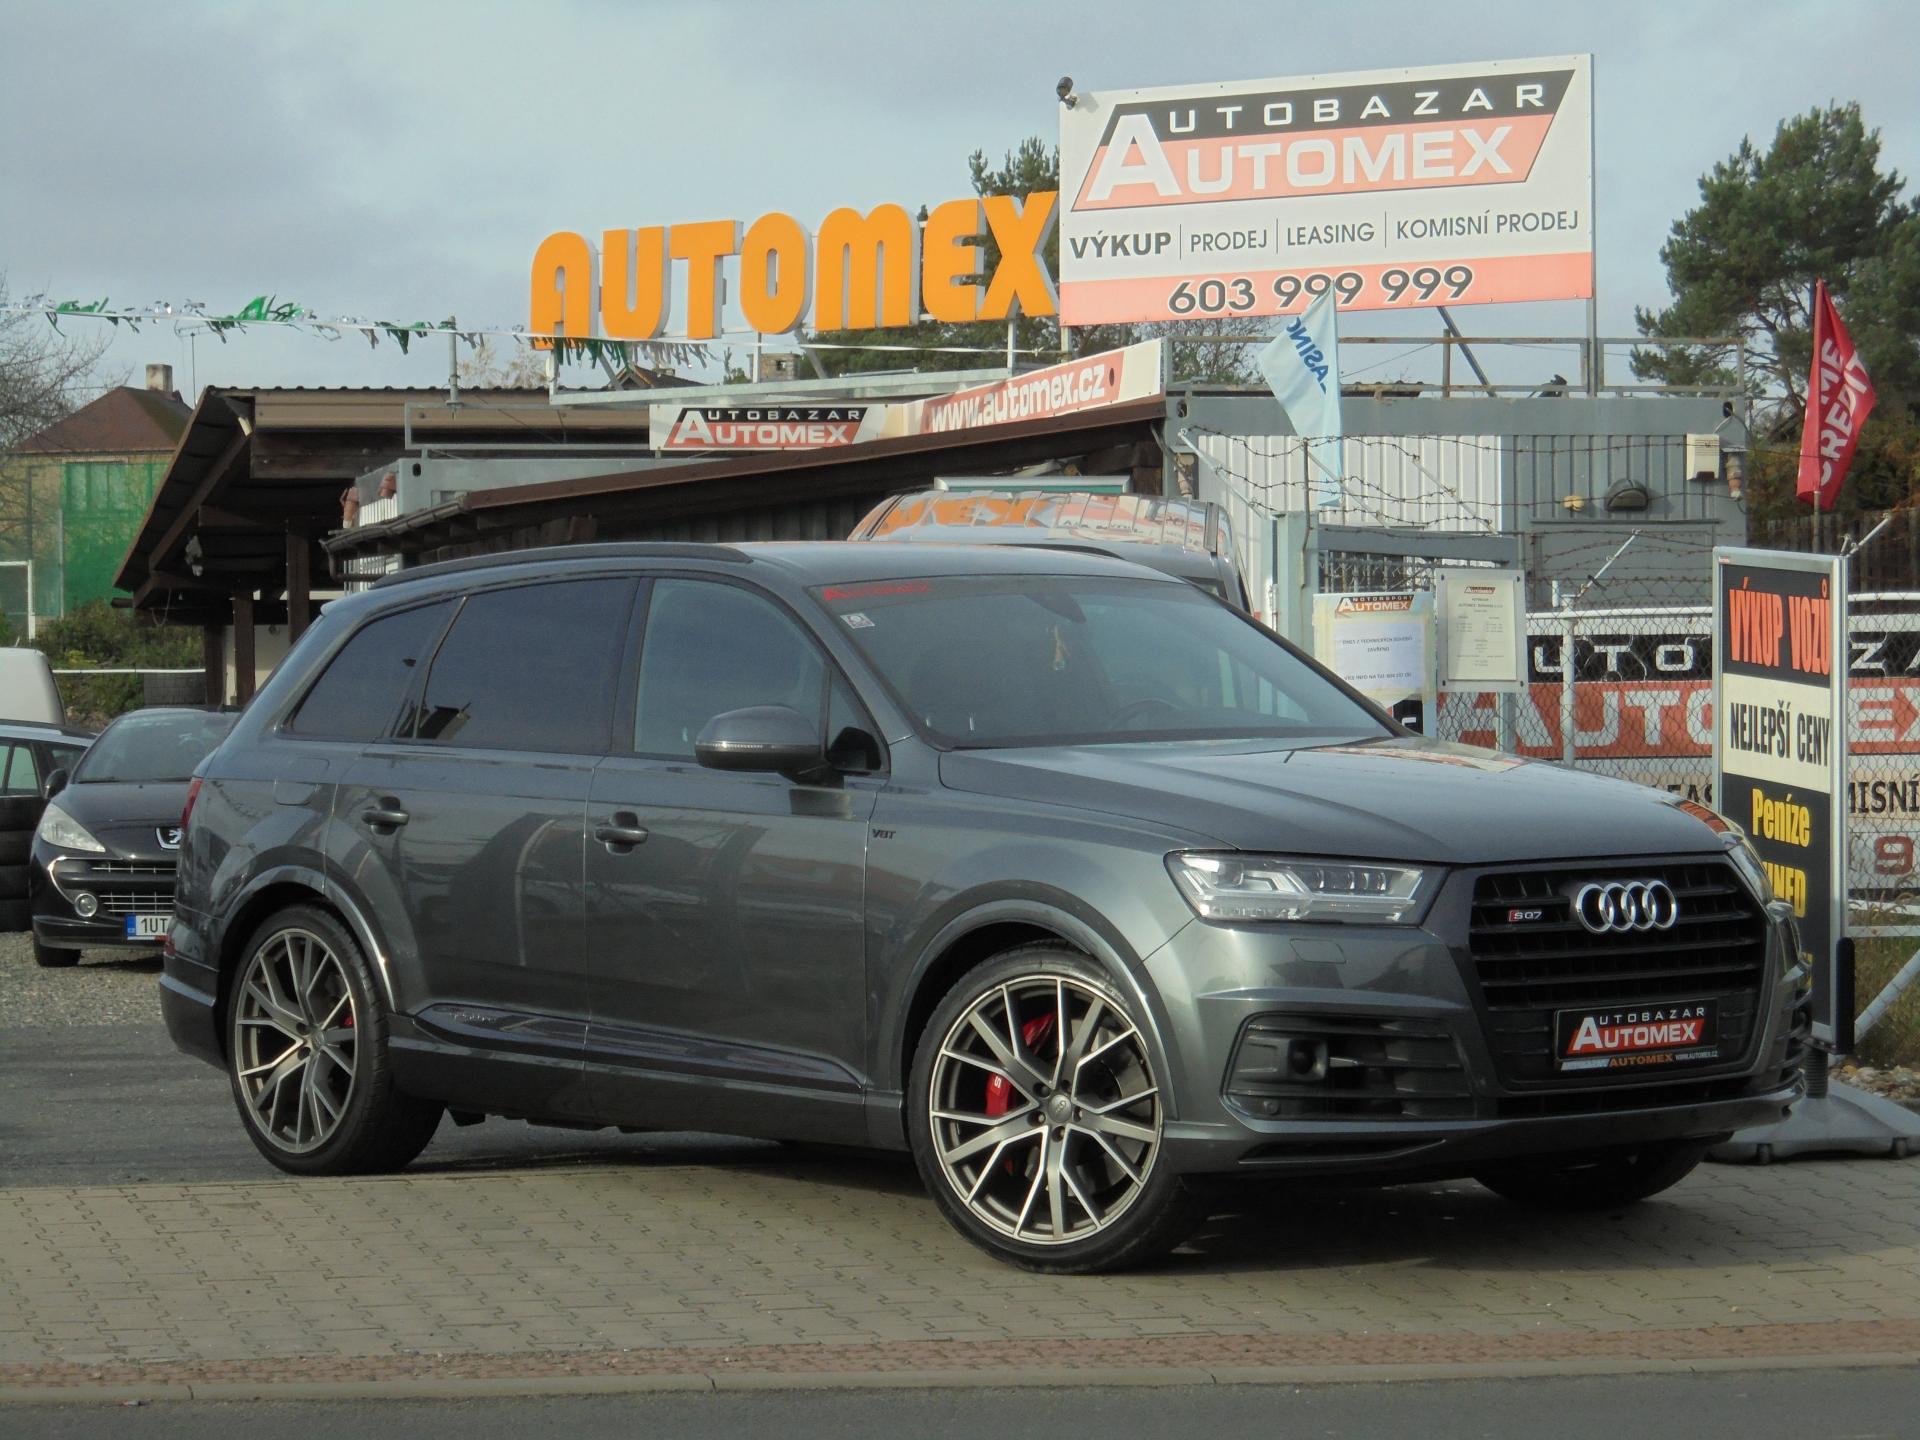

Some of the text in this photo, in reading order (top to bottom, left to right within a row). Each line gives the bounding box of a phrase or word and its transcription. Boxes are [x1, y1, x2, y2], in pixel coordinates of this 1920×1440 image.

[1086, 113, 1513, 201] AUTOMEX
[1069, 210, 1579, 260] VÝKUP PRODEJ LEASING KOMISNÍ PRODEJ
[530, 191, 1060, 350] AUTOMEX
[1168, 265, 1473, 315] 603 999 999
[931, 363, 1105, 433] www.automex.cz
[672, 410, 848, 444] AUTOMEX
[1338, 597, 1408, 612] AUTOMEX
[1729, 576, 1831, 676] VÝKUP VOZŮ
[1730, 699, 1831, 767] NEJLEPŠÍ CENY
[1752, 788, 1810, 848] Peníze
[1513, 910, 1542, 920] SQ7
[1572, 1016, 1697, 1051] AUTOMEX
[1609, 1053, 1674, 1068] AUTOMEX
